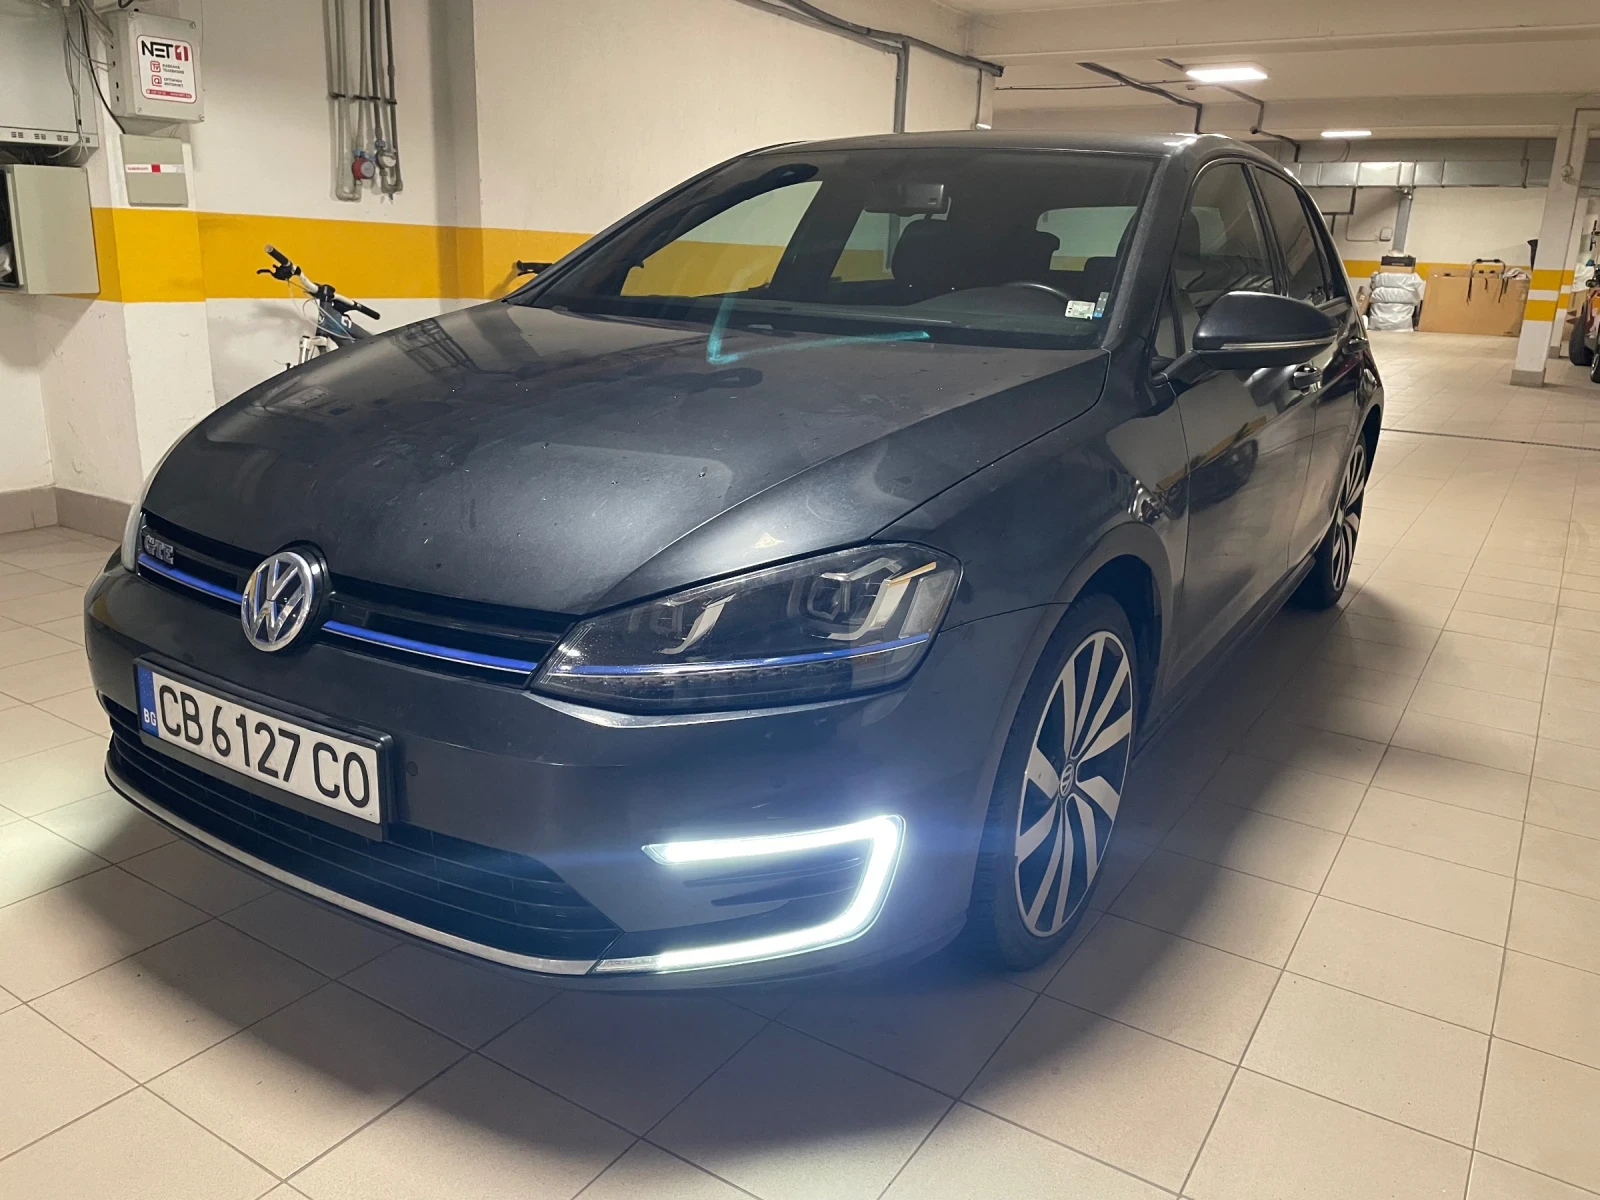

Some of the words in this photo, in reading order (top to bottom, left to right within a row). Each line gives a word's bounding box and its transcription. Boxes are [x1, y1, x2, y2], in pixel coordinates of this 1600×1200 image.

[143, 707, 157, 726] BG
[159, 684, 204, 746] CB
[212, 705, 300, 783] 6127
[312, 741, 370, 809] CO
